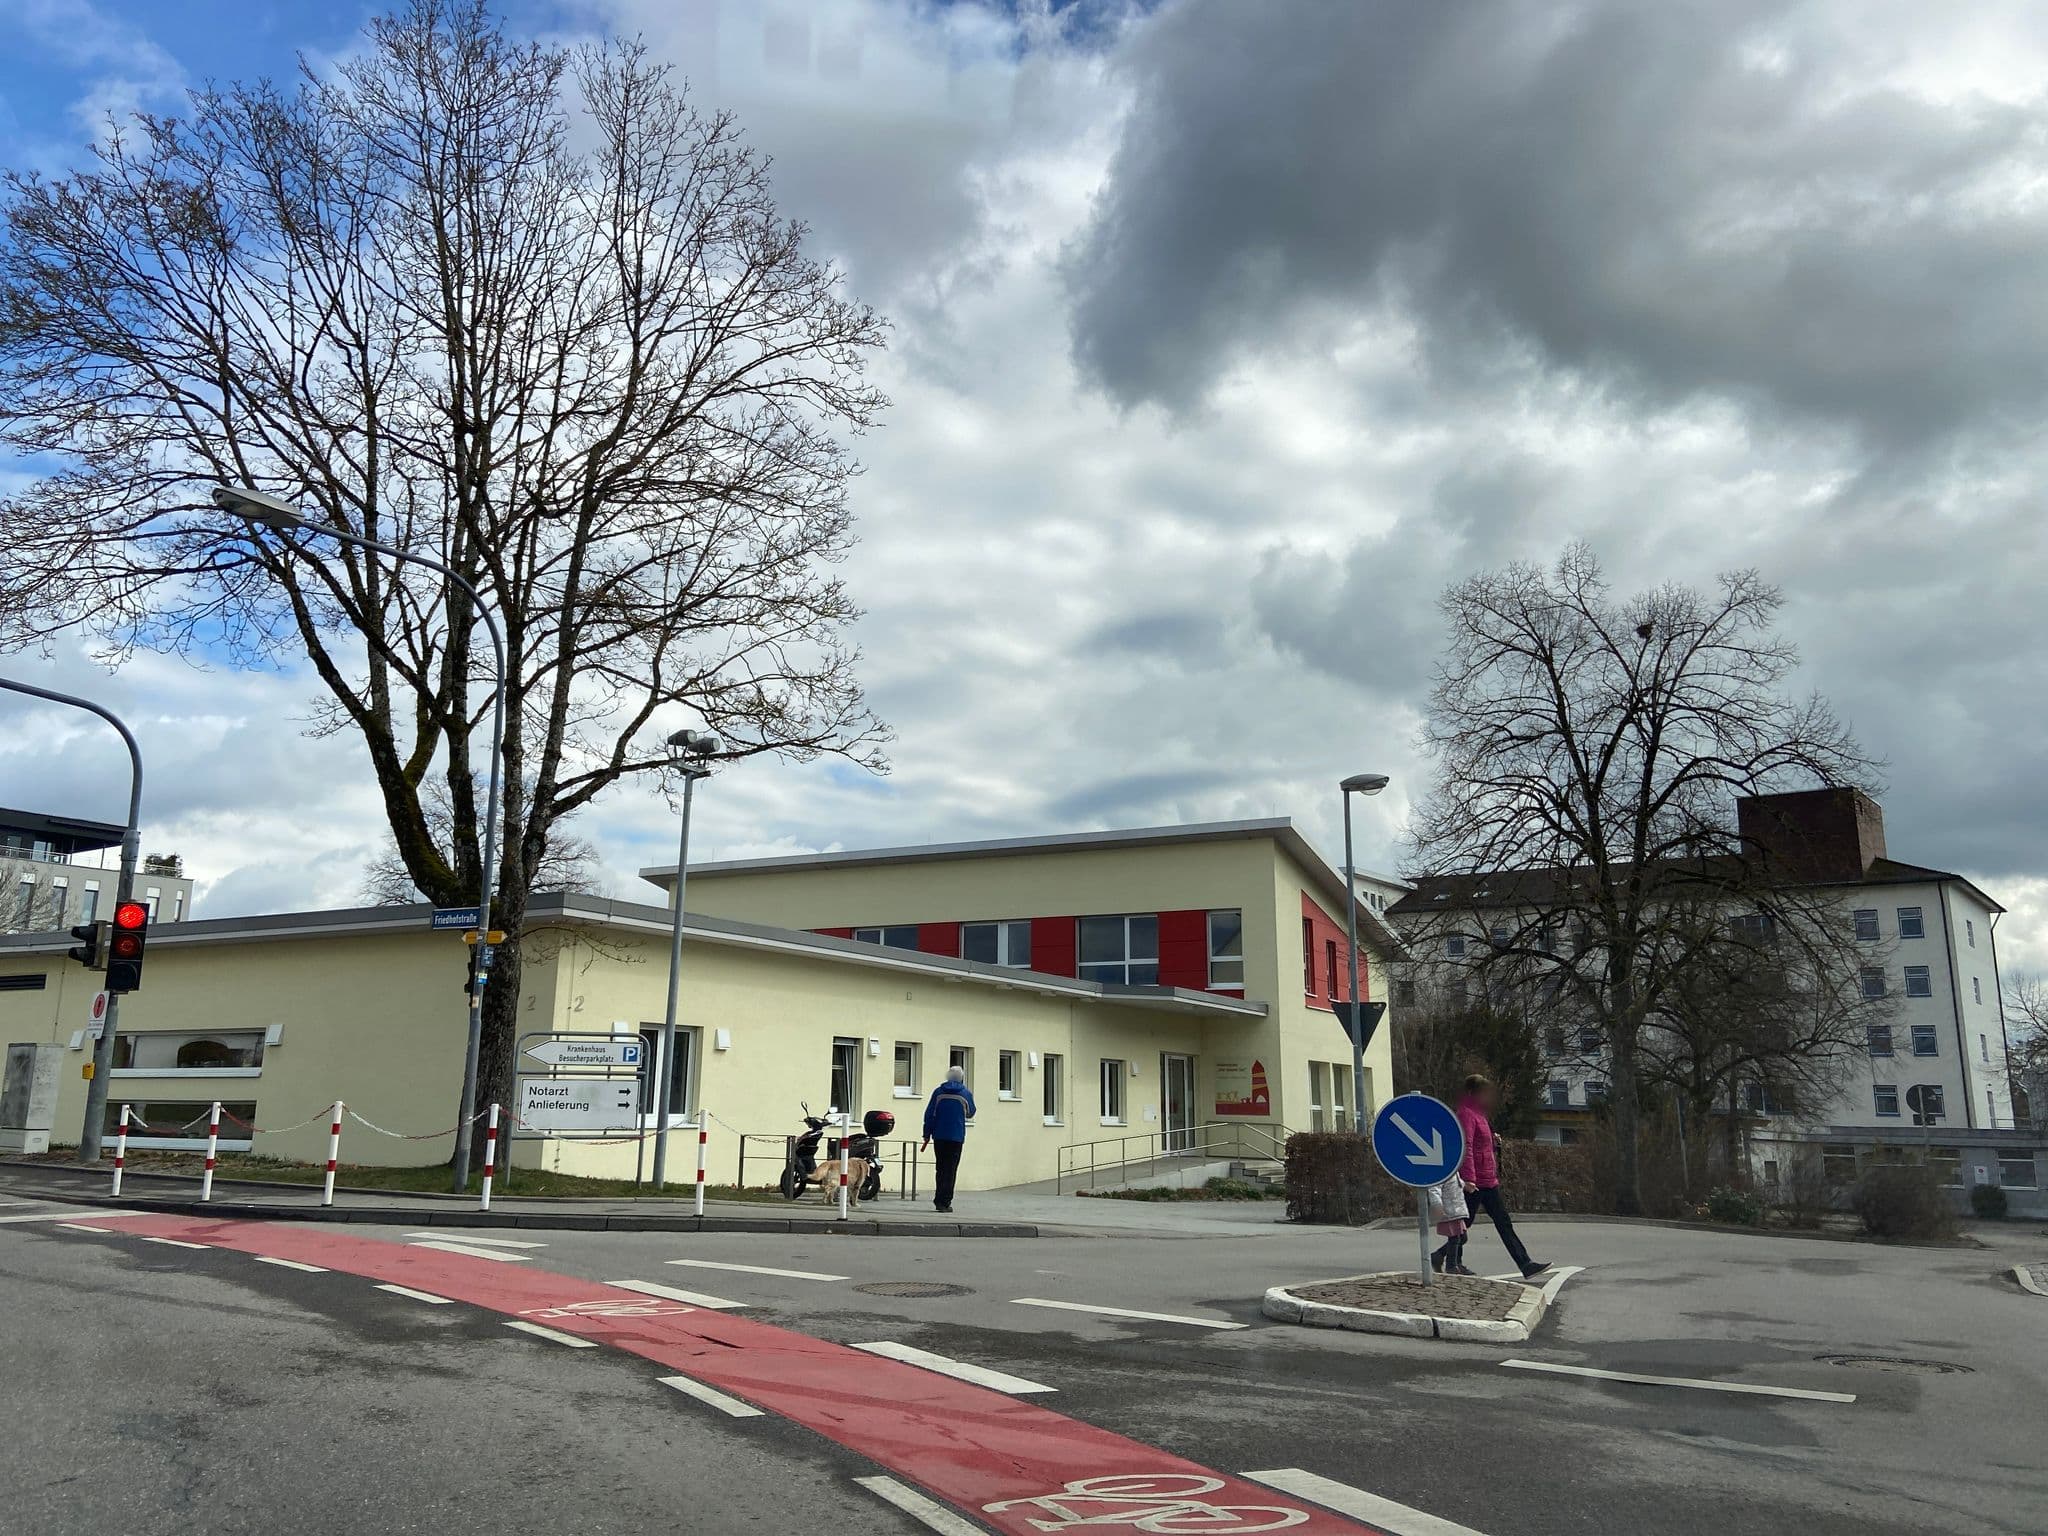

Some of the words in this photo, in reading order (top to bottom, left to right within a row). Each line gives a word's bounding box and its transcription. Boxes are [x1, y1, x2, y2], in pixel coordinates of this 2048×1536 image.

[434, 913, 477, 925] Friedhofstraße
[528, 995, 536, 1011] 2
[574, 995, 584, 1012] 2
[567, 1045, 606, 1053] Krankenhaus
[626, 1047, 636, 1060] P
[558, 1054, 614, 1063] Besucherparkplatz
[529, 1086, 569, 1096] Notarzt
[528, 1100, 589, 1111] Anlieferung
